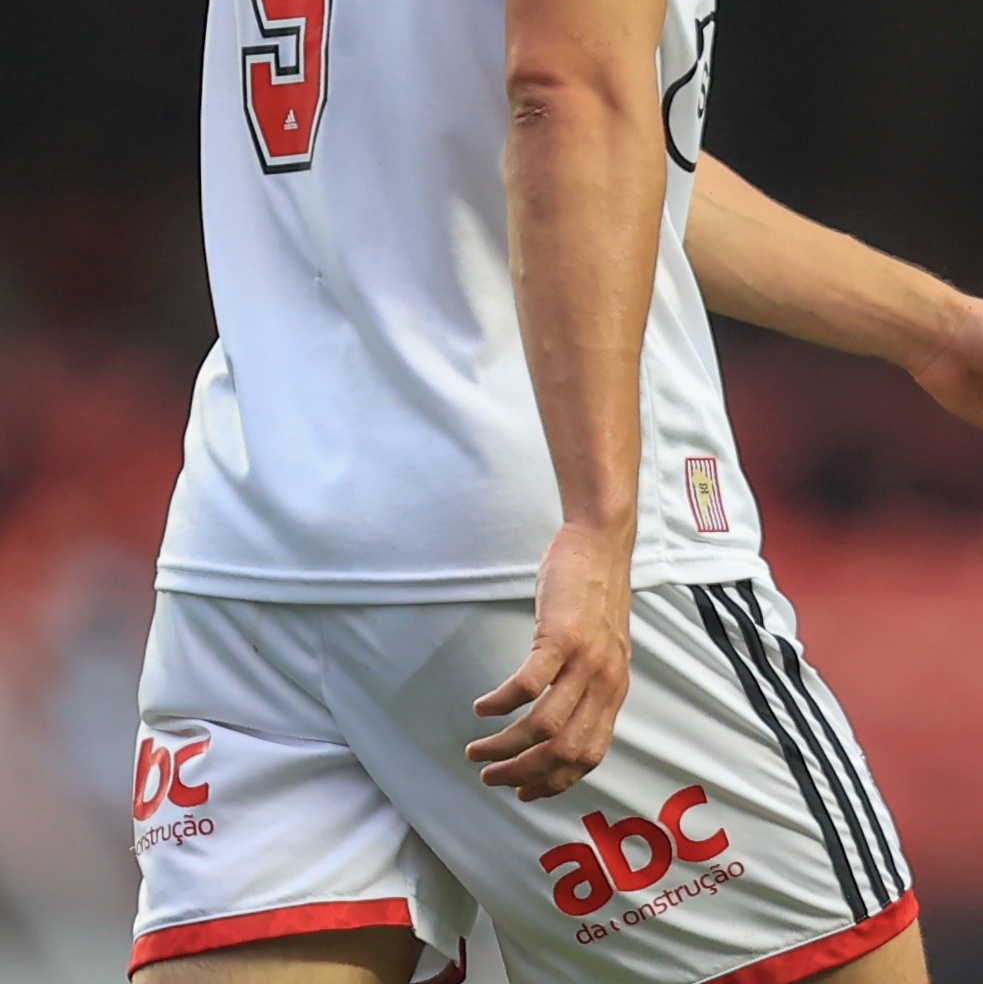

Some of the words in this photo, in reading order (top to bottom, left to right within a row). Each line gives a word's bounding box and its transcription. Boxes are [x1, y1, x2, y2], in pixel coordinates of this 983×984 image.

[132, 737, 210, 822] bc
[539, 784, 729, 917] abc
[575, 923, 608, 945] da
